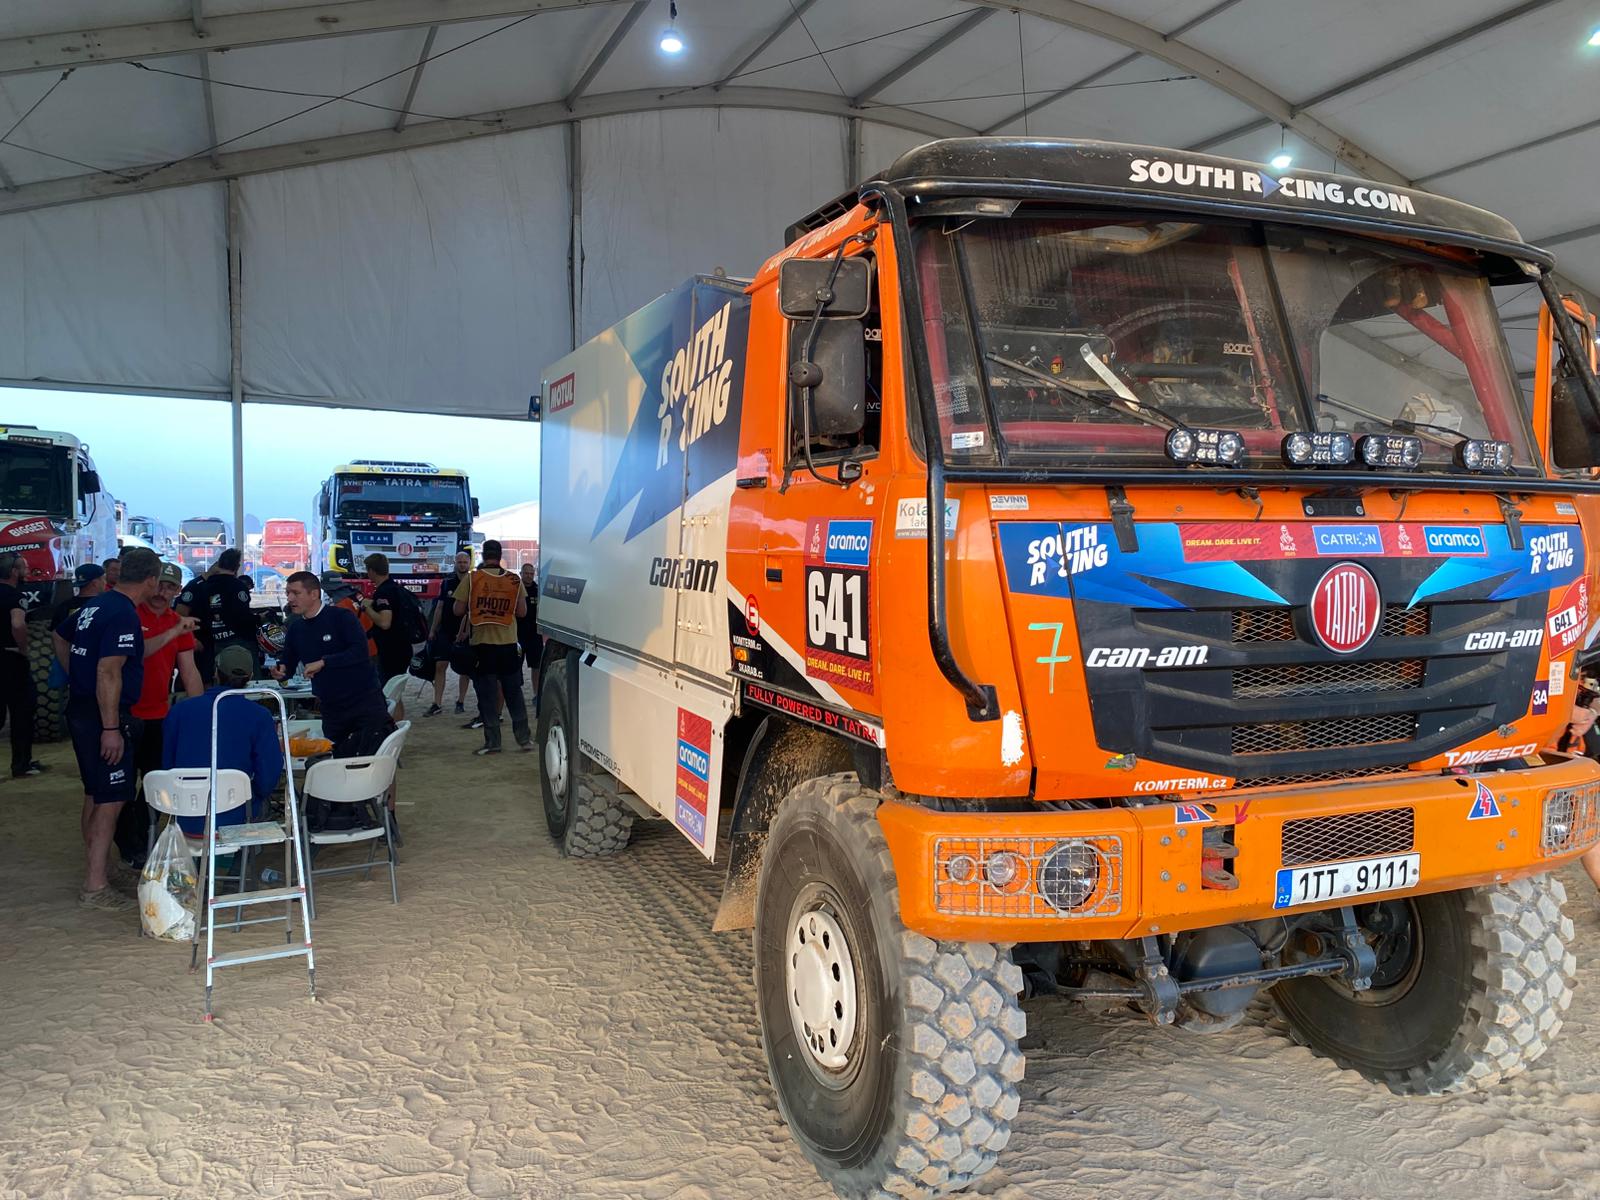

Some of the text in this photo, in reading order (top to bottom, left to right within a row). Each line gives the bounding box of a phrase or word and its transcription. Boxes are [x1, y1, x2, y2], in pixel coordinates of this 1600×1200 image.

[1129, 158, 1235, 191] SOUTH
[1223, 342, 1253, 354] sparc
[657, 301, 731, 419] SOUTH
[551, 379, 573, 409] MOTUL
[384, 478, 422, 488] TATRA
[8, 521, 48, 537] BIGGEST
[1429, 533, 1480, 547] aramco
[829, 534, 868, 551] aramco
[1027, 525, 1098, 564] SOUTH
[1185, 539, 1214, 547] DREAM.
[1530, 531, 1569, 557] SOUTH
[649, 557, 719, 594] can-am
[476, 596, 511, 611] PHOTO
[807, 570, 867, 657] 641
[1325, 571, 1366, 645] TATRA
[1554, 611, 1573, 632] 641
[212, 630, 235, 640] ATRA
[1465, 628, 1544, 651] can-am
[1028, 622, 1073, 695] 7
[1086, 645, 1209, 668] can-am
[807, 658, 829, 672] DREAM.
[829, 663, 847, 676] DARE.
[848, 667, 863, 680] LIVE
[1533, 690, 1548, 706] 3A
[749, 686, 878, 742] FULLY POWERED BY TATRA
[679, 746, 707, 775] aramco
[1445, 742, 1538, 767] TAVESCO
[1133, 777, 1227, 792] KOMTERM.cz
[1299, 859, 1408, 900] 1TT 9111
[1278, 894, 1290, 904] CZ
